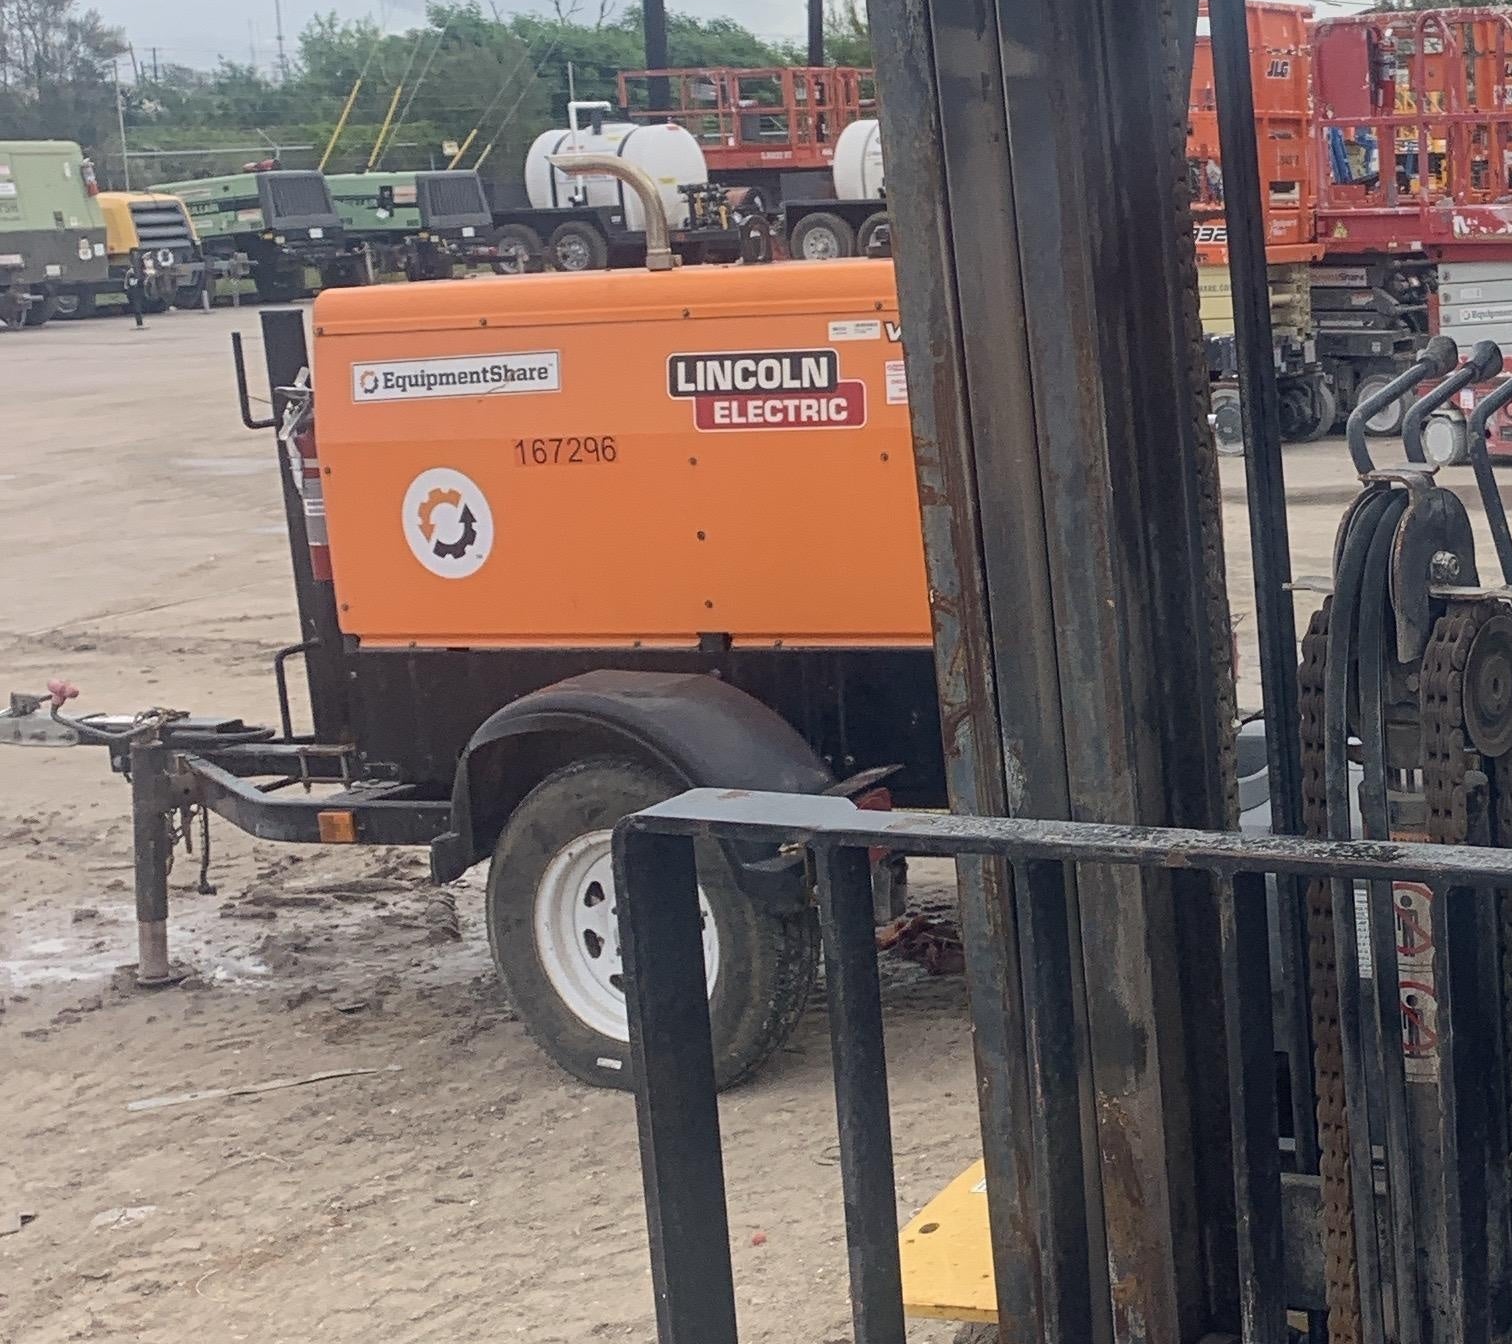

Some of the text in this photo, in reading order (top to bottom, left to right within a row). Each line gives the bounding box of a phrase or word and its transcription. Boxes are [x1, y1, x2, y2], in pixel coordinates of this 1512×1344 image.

[1267, 60, 1289, 77] JLG
[382, 364, 549, 393] EquipmentShare
[676, 357, 829, 392] LINCOLN
[713, 397, 848, 424] ELECTRIC
[515, 436, 617, 465] 167296
